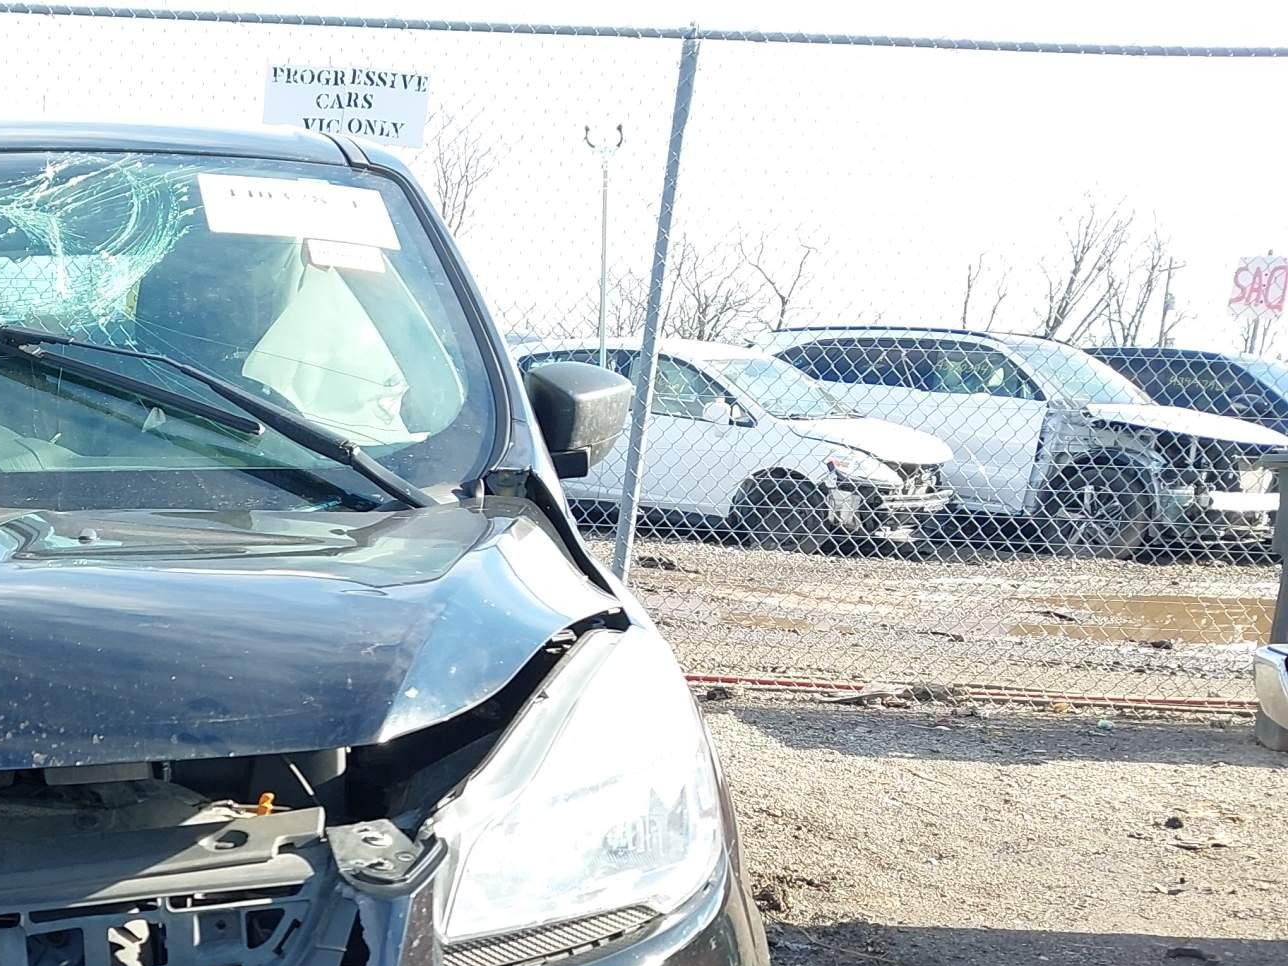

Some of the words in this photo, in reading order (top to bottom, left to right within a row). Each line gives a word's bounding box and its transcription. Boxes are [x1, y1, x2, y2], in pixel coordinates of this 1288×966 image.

[272, 67, 429, 93] PROGRESSIVE
[315, 91, 374, 110] CARS
[302, 117, 340, 135] VIC
[347, 118, 405, 138] ONLY
